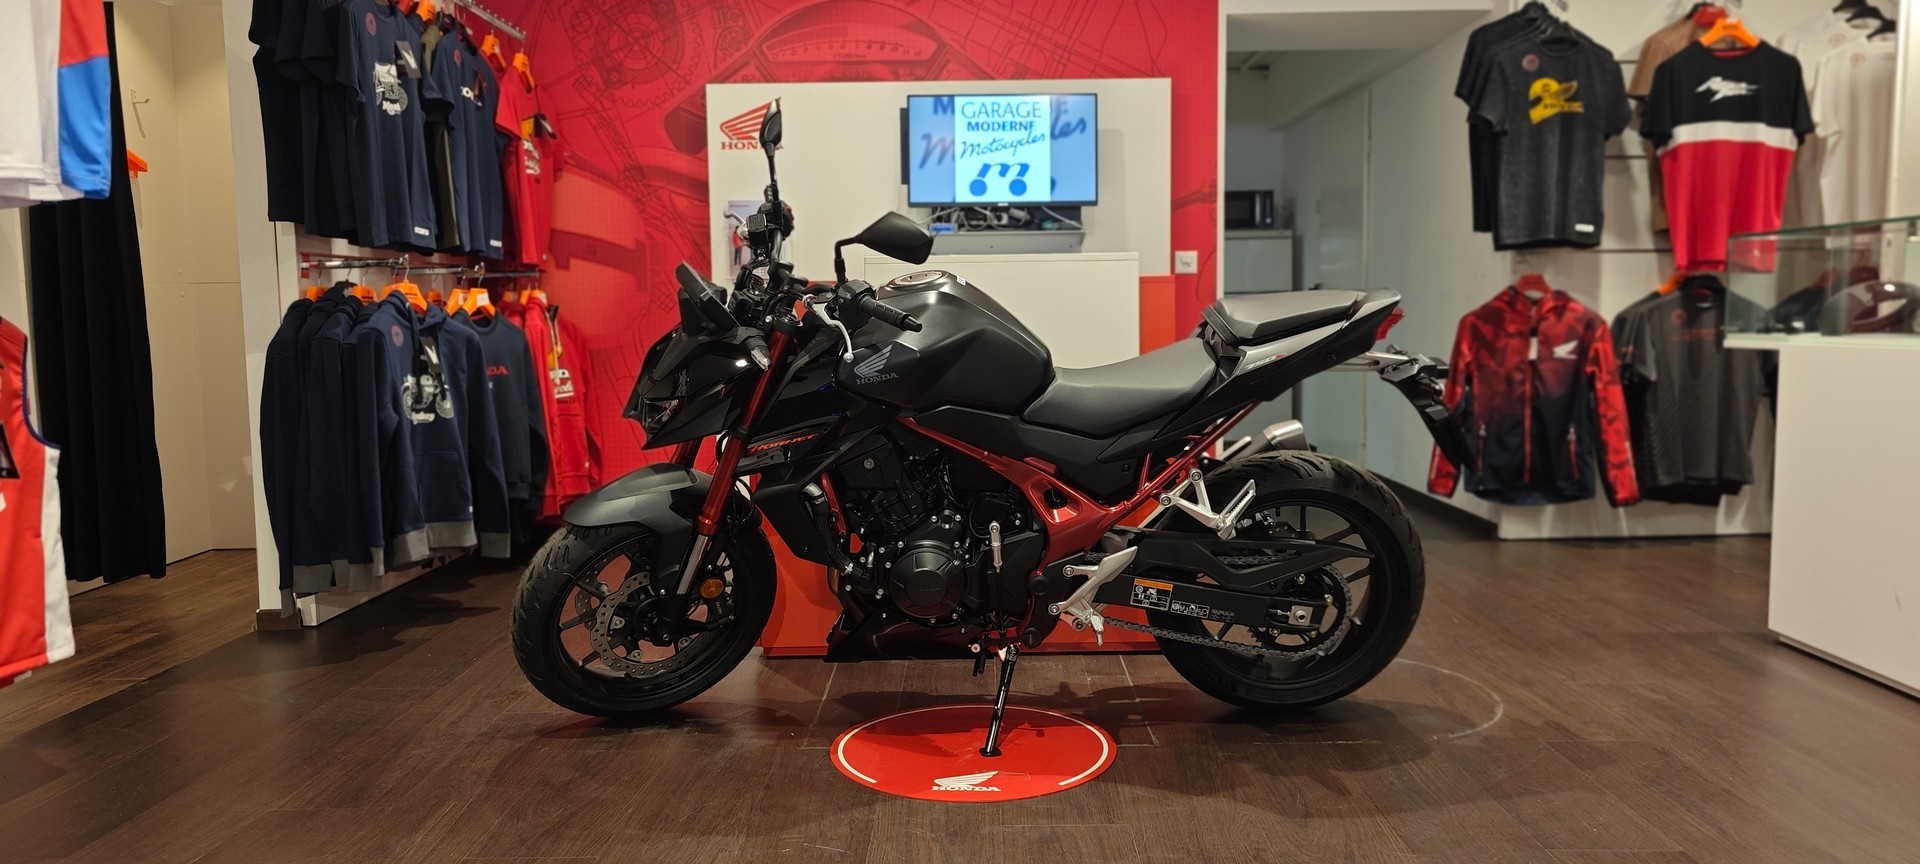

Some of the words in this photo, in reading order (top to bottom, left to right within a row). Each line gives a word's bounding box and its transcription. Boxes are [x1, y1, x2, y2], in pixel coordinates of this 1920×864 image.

[961, 101, 1042, 119] GARAGE
[967, 121, 1037, 132] MODERNE
[960, 128, 1046, 159] Motocycles
[856, 373, 899, 385] HONDA
[747, 433, 819, 454] HORNET
